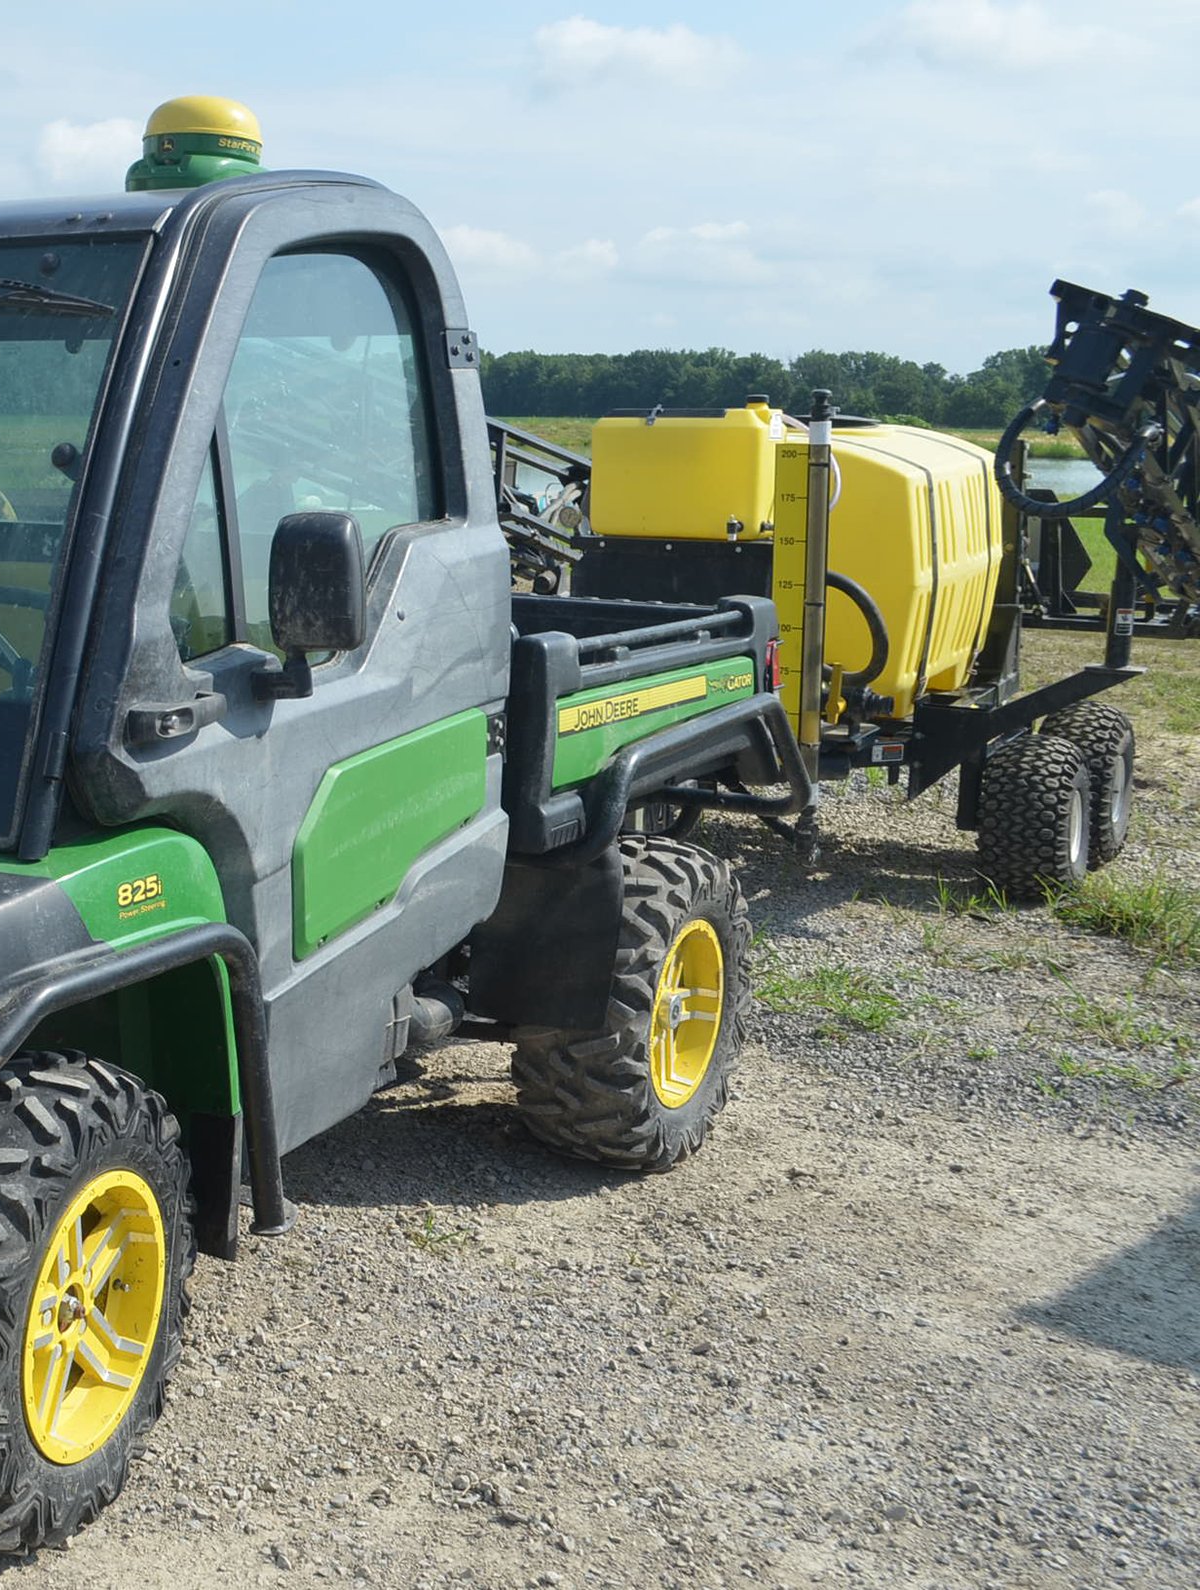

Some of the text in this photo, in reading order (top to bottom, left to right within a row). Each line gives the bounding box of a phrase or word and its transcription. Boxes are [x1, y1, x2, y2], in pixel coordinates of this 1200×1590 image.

[781, 450, 797, 458] 200
[781, 493, 795, 502] 175
[779, 537, 794, 545] 150
[778, 580, 793, 589] 125
[727, 674, 752, 690] GATOR
[574, 698, 639, 728] JOHN DEERE
[118, 874, 161, 906] 825i
